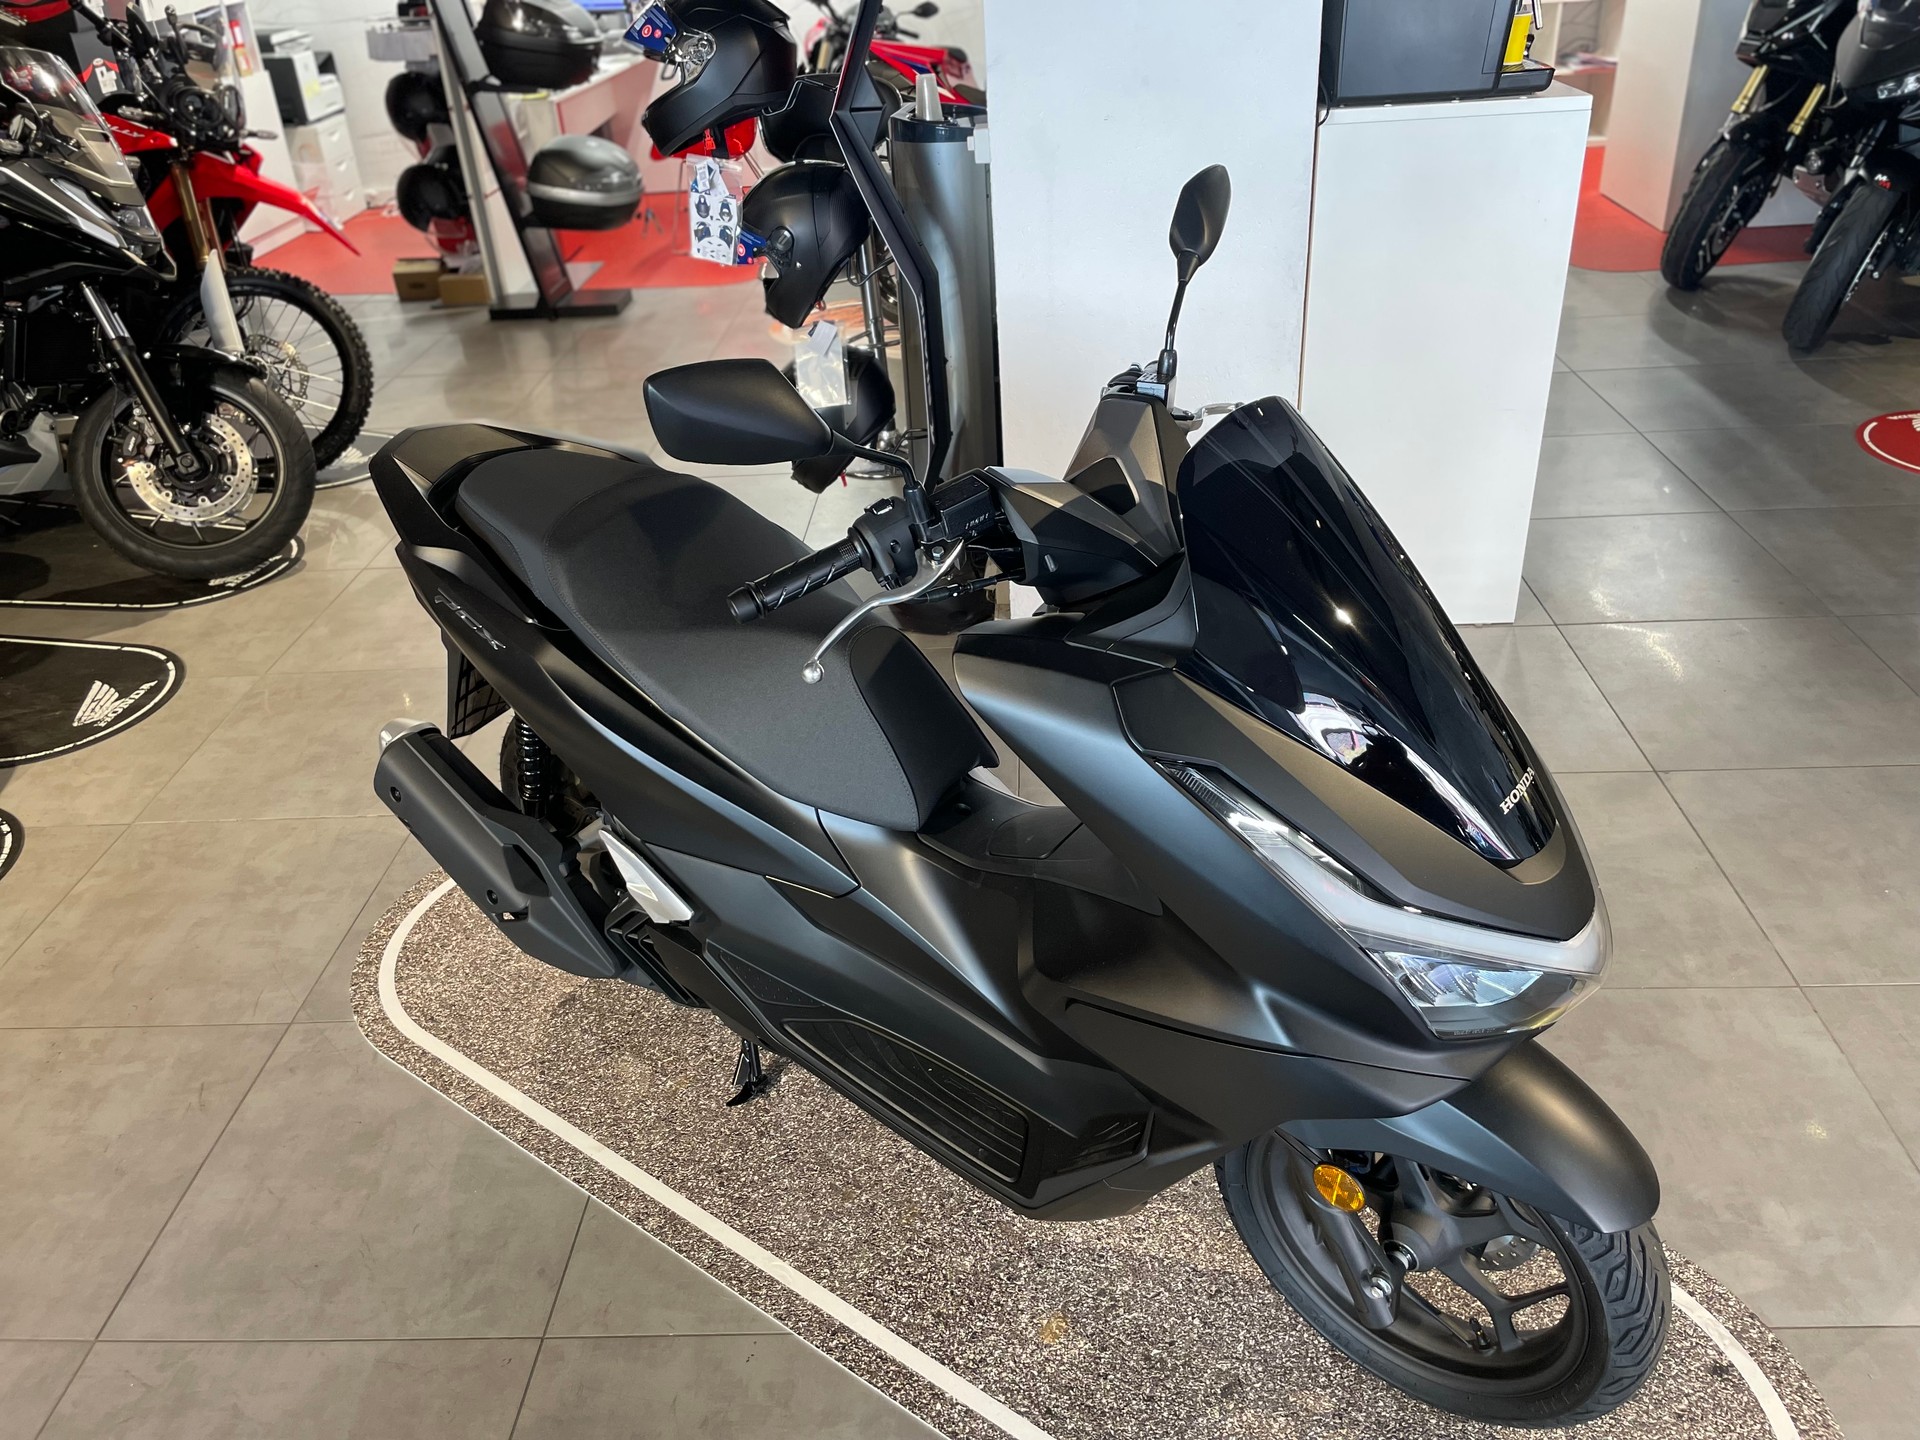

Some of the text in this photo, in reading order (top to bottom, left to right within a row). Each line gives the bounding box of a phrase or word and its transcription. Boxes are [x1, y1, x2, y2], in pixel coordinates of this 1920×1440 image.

[434, 587, 506, 650] PCX
[93, 680, 159, 727] HONDA
[1499, 766, 1535, 815] HONDA
